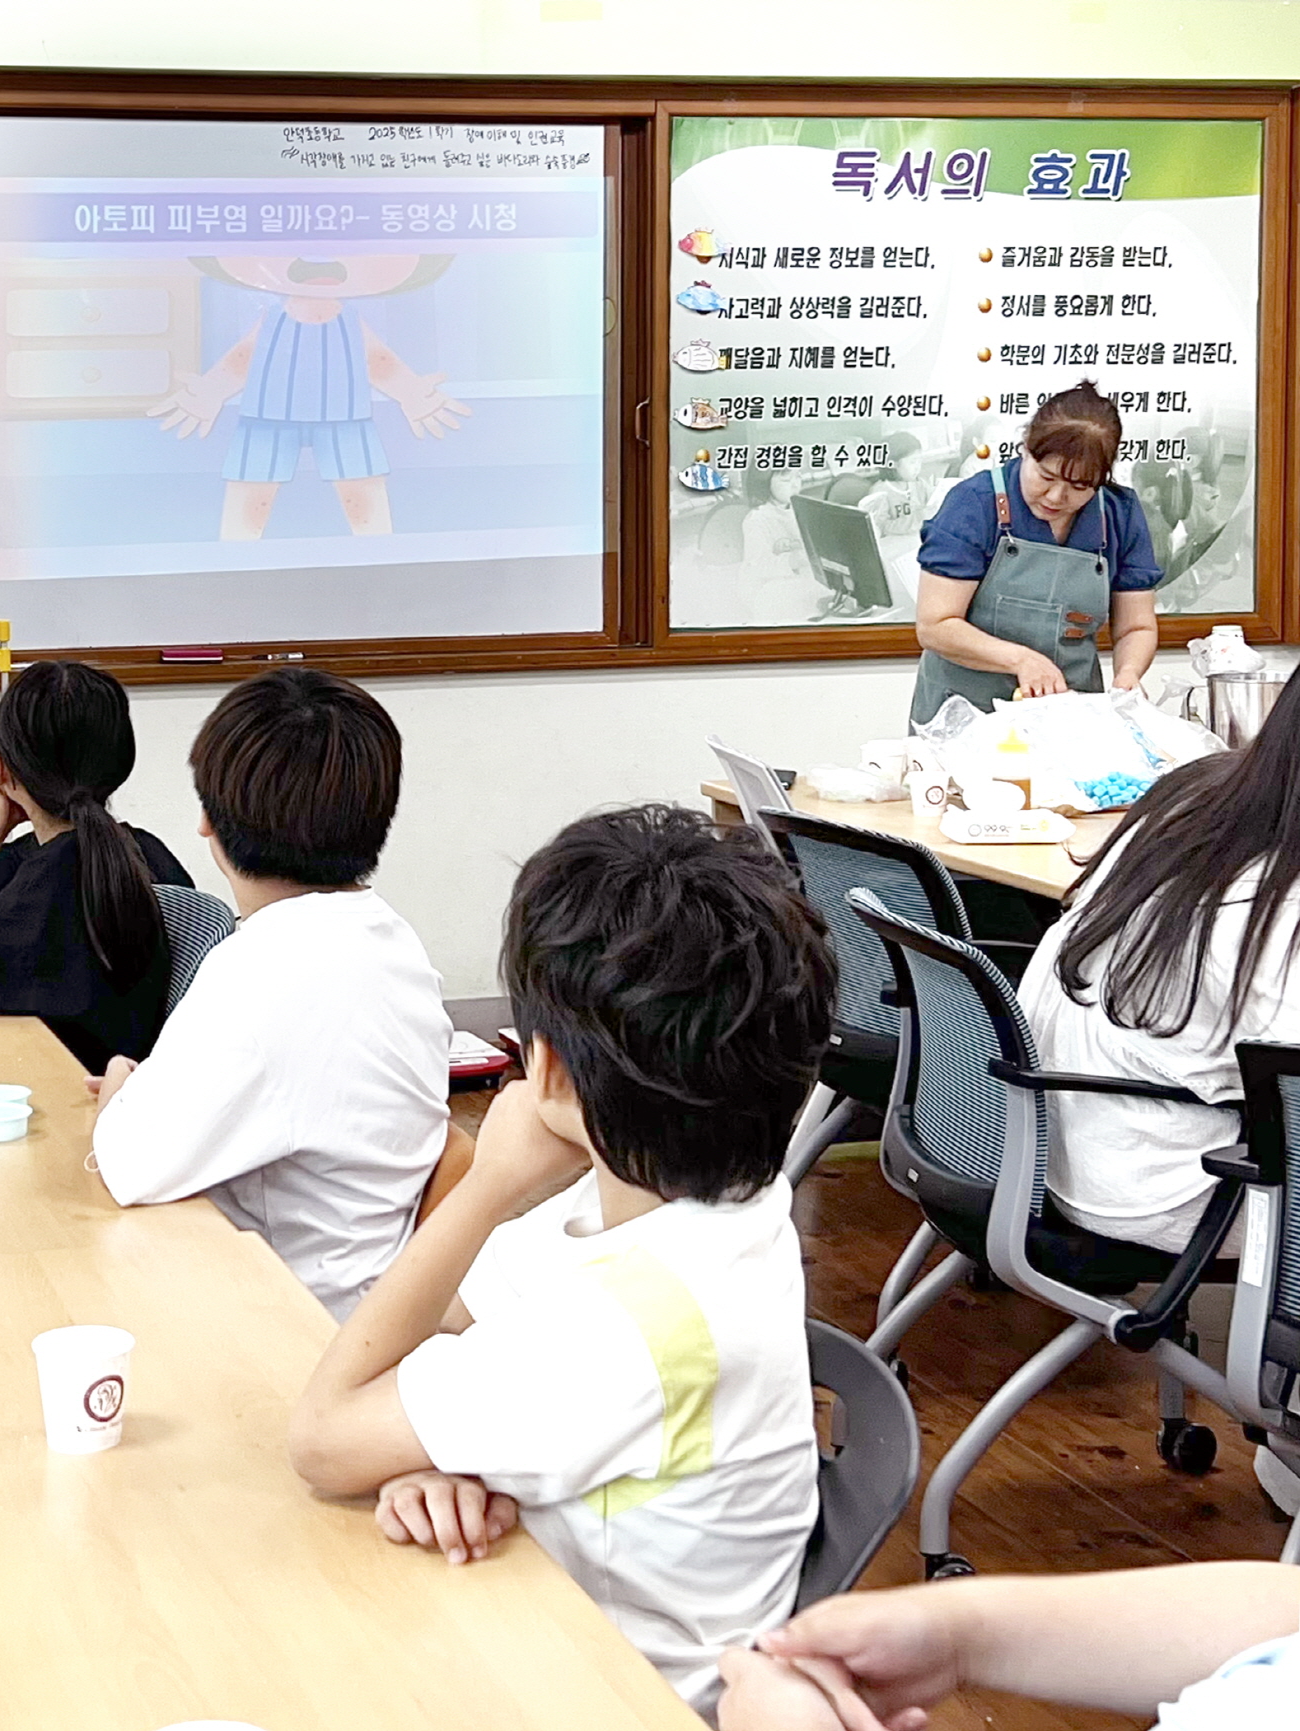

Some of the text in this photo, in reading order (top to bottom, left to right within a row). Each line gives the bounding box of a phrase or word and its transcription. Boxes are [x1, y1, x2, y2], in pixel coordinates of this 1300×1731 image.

[283, 126, 345, 143] 안덕초등학교
[831, 150, 1130, 199] 독서의 효과
[74, 203, 155, 233] 아토피
[168, 204, 247, 232] 피부염
[381, 204, 458, 231] 동영상
[468, 203, 518, 231] 시청
[774, 247, 820, 268] 새로운
[830, 247, 875, 268] 정보를
[883, 247, 934, 268] 얻는다.
[1002, 246, 1171, 268] 즐거움과 감동을 받는다.
[790, 296, 851, 319] 상상력을
[860, 296, 926, 318] 길러준다.
[1002, 295, 1156, 317] 정서를 풍요롭게 한다.
[789, 347, 835, 368] 지혜를
[844, 346, 894, 368] 얻는다.
[1001, 342, 1236, 365] 학문의 기초와 전문성을 길러준다.
[719, 395, 947, 419] 교양을 넓히고 인격이 수양된다.
[1001, 394, 1029, 414] 바른
[1157, 391, 1190, 412] 한다.
[718, 445, 892, 468] 간접 경험을 할 수 있다.
[1120, 439, 1149, 461] 갖게
[1157, 439, 1190, 460] 한다.
